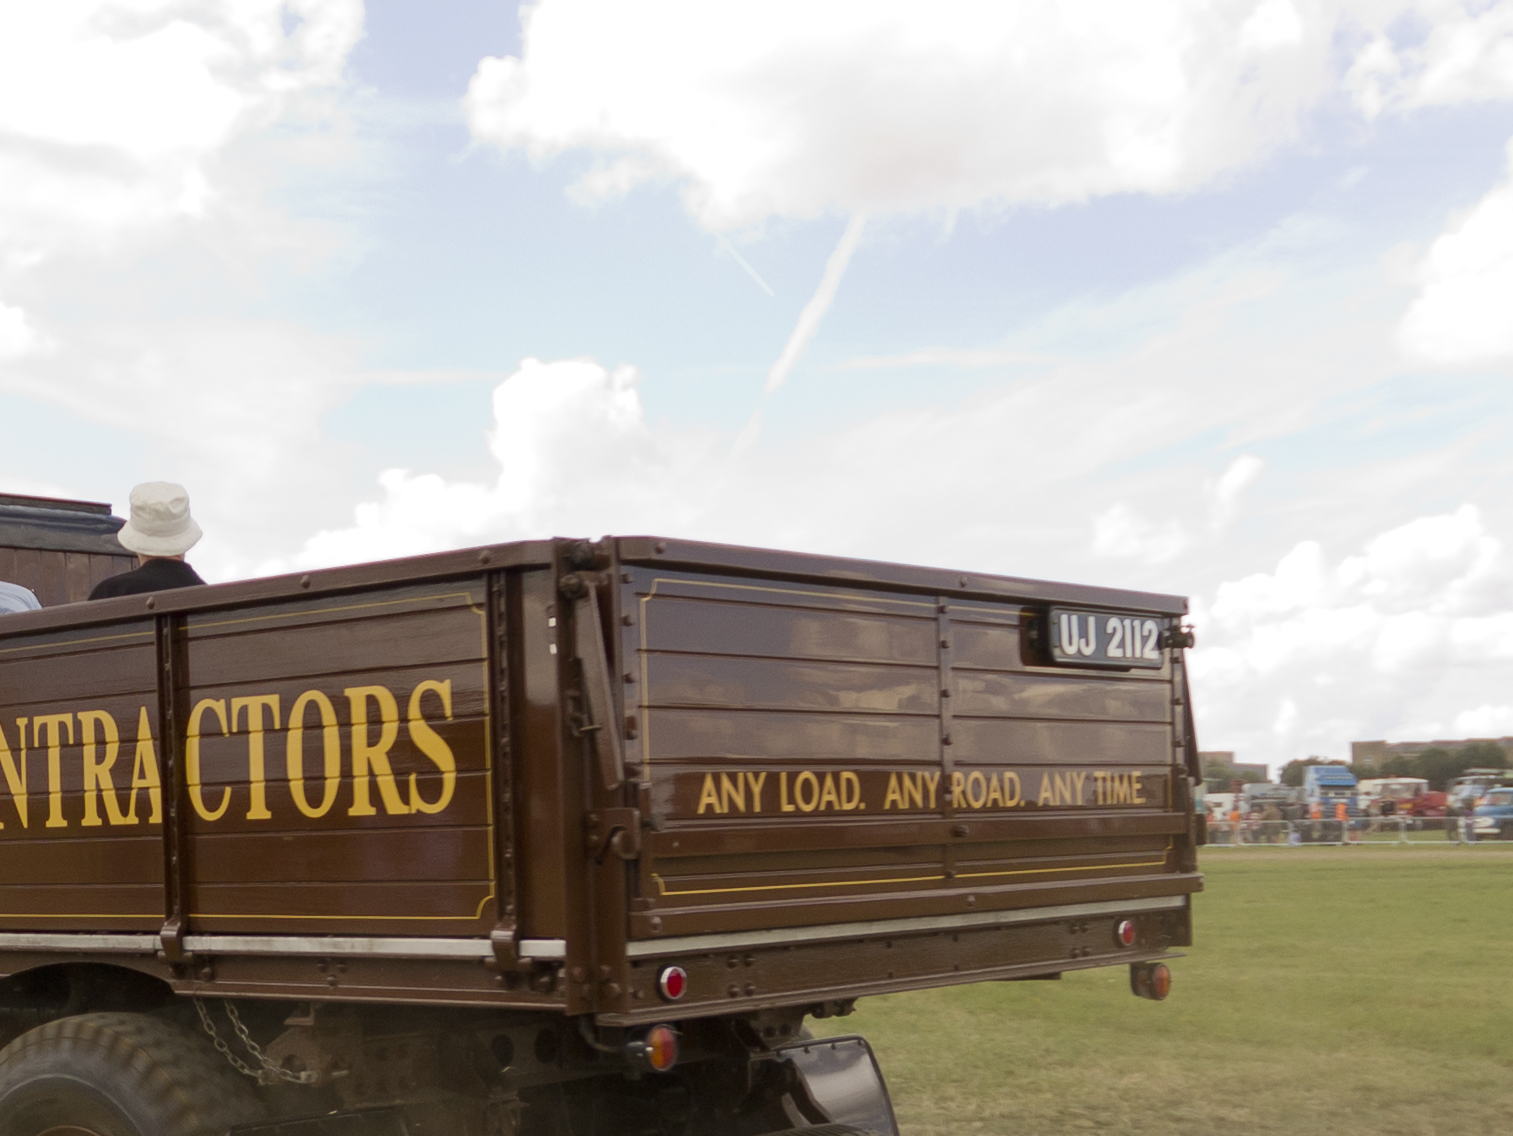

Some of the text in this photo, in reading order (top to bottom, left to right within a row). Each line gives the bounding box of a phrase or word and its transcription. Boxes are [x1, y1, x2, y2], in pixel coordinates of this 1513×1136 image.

[1060, 613, 1159, 660] UJ 2112
[697, 770, 1147, 815] ANY LOAD. ANY ROAD. ANY TIME
